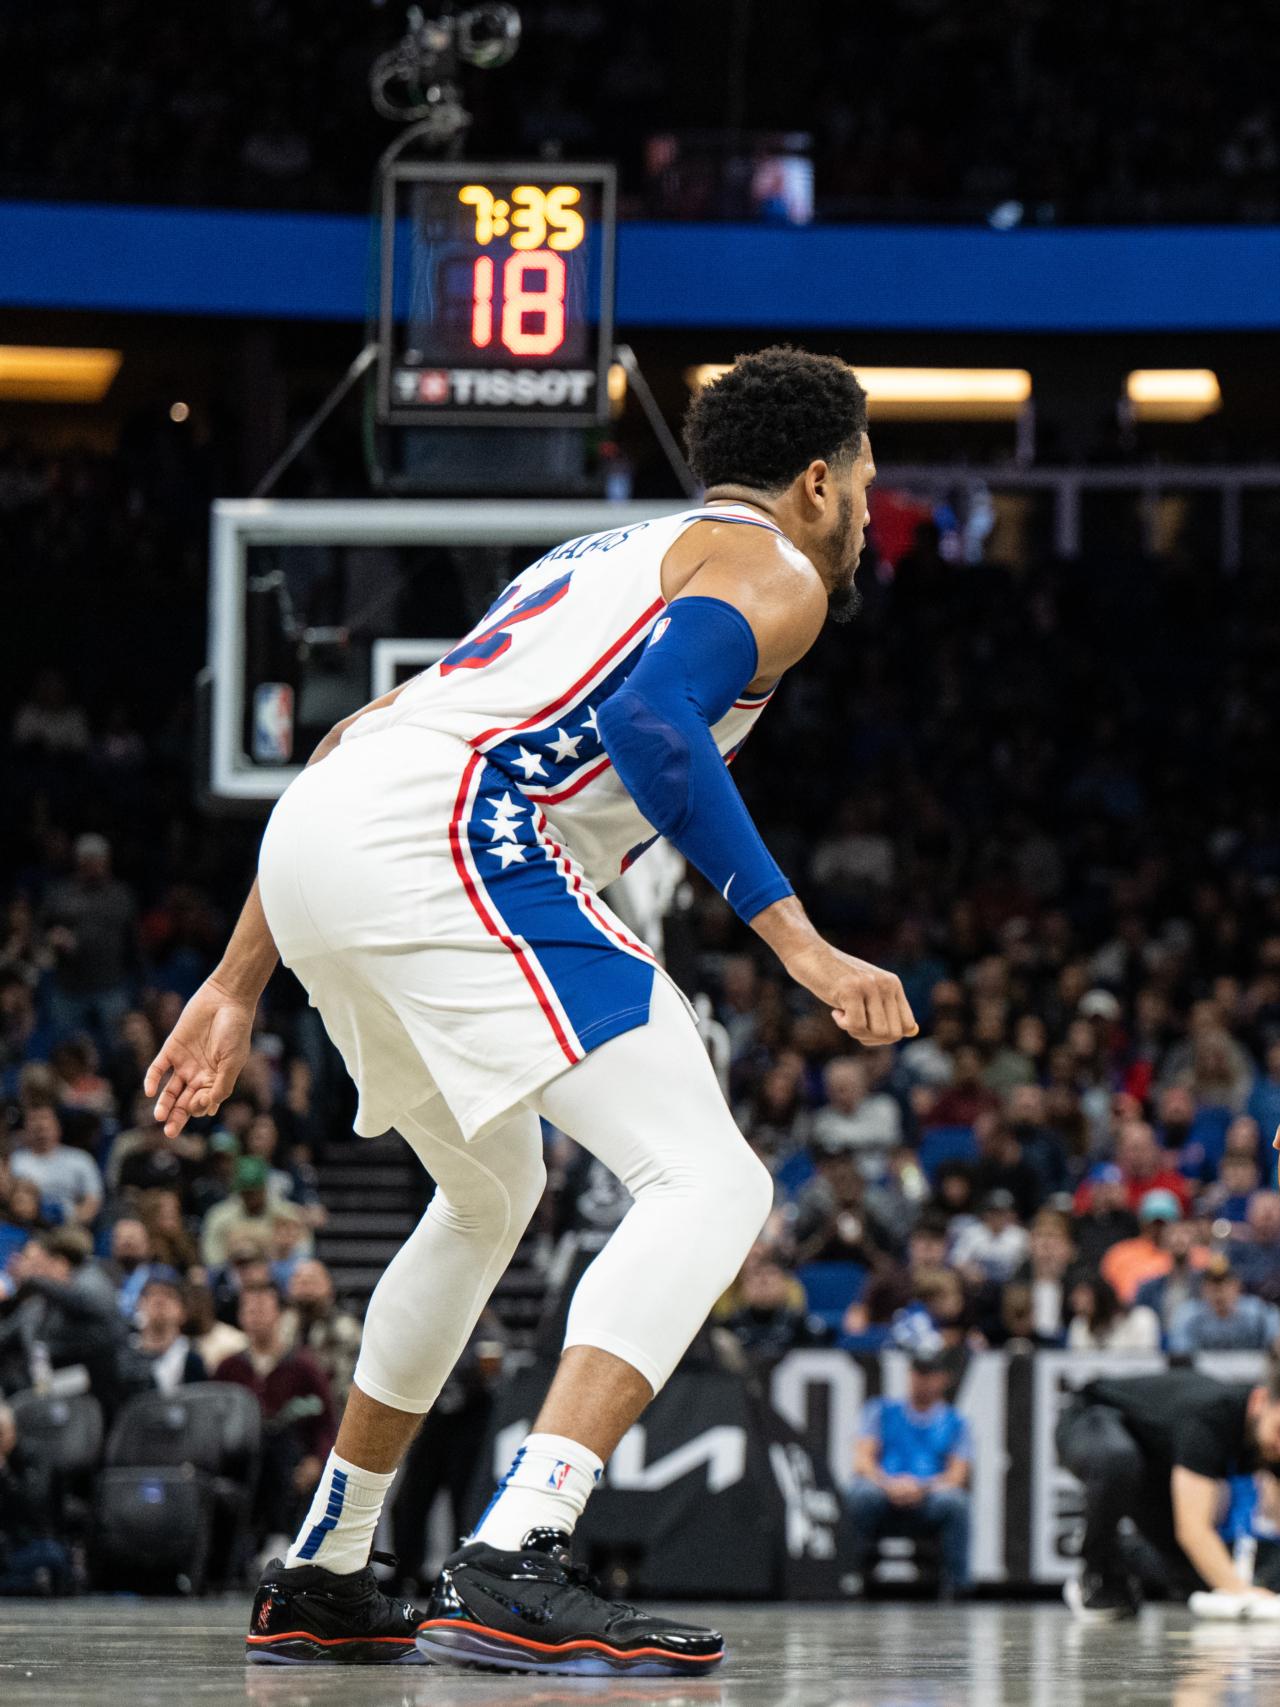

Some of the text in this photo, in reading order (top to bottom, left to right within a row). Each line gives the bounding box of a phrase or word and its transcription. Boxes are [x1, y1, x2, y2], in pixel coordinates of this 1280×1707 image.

[459, 185, 584, 250] 7:35
[471, 250, 566, 355] 18
[450, 368, 596, 406] TISSOT
